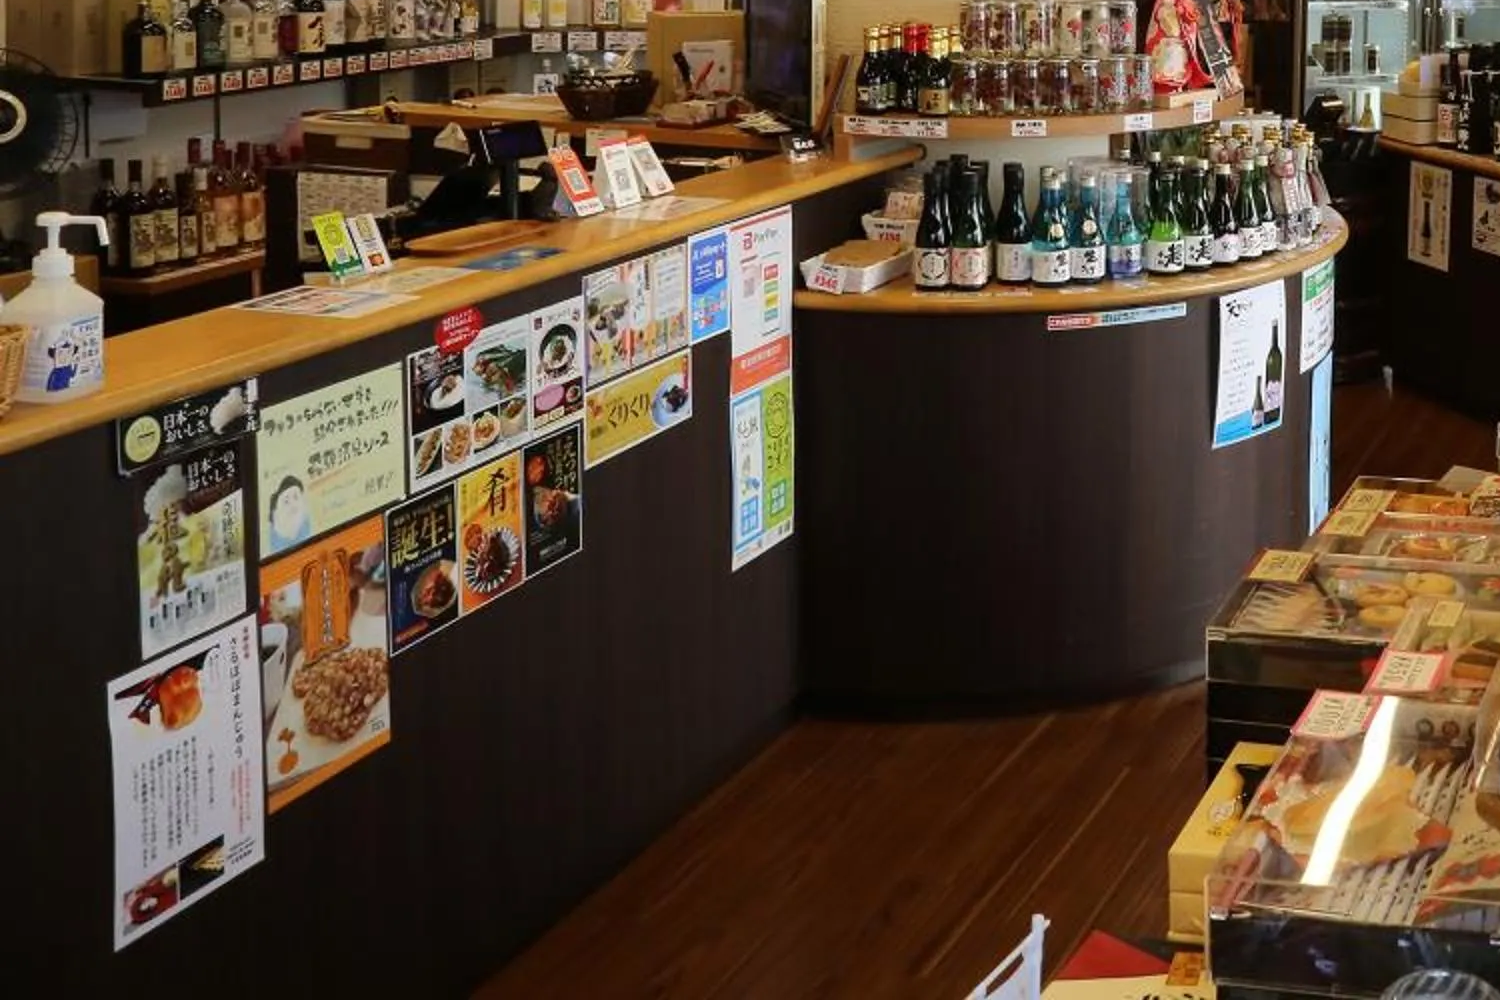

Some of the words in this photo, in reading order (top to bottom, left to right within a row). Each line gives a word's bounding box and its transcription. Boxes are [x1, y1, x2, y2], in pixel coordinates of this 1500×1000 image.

[164, 405, 209, 431] 日本一の
[607, 392, 650, 428] くりくり
[165, 420, 209, 443] おいしさ
[187, 450, 235, 480] 日本一の
[188, 463, 235, 492] おいしさ
[482, 467, 510, 517] 肴
[391, 503, 454, 569] 誕生!
